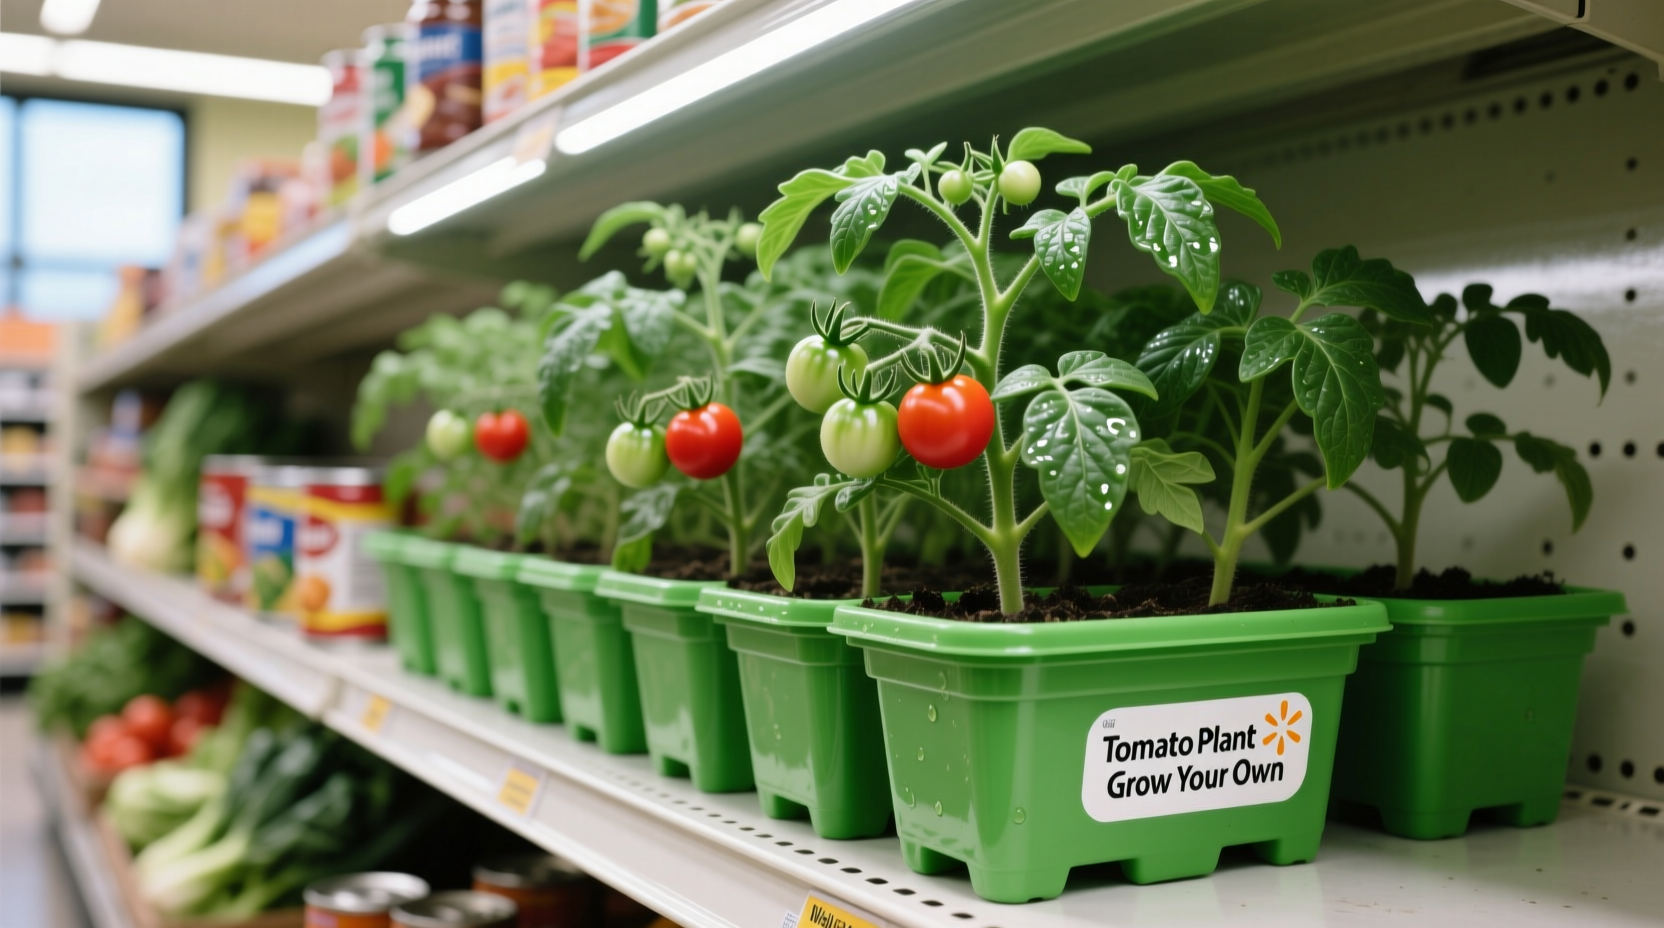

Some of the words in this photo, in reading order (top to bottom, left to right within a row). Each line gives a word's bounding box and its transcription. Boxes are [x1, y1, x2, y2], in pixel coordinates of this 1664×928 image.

[1102, 731, 1194, 763] Tomato
[1197, 724, 1257, 754] Plant
[1107, 770, 1173, 799] Grow
[1177, 765, 1229, 793] Your
[1232, 758, 1284, 786] Own
